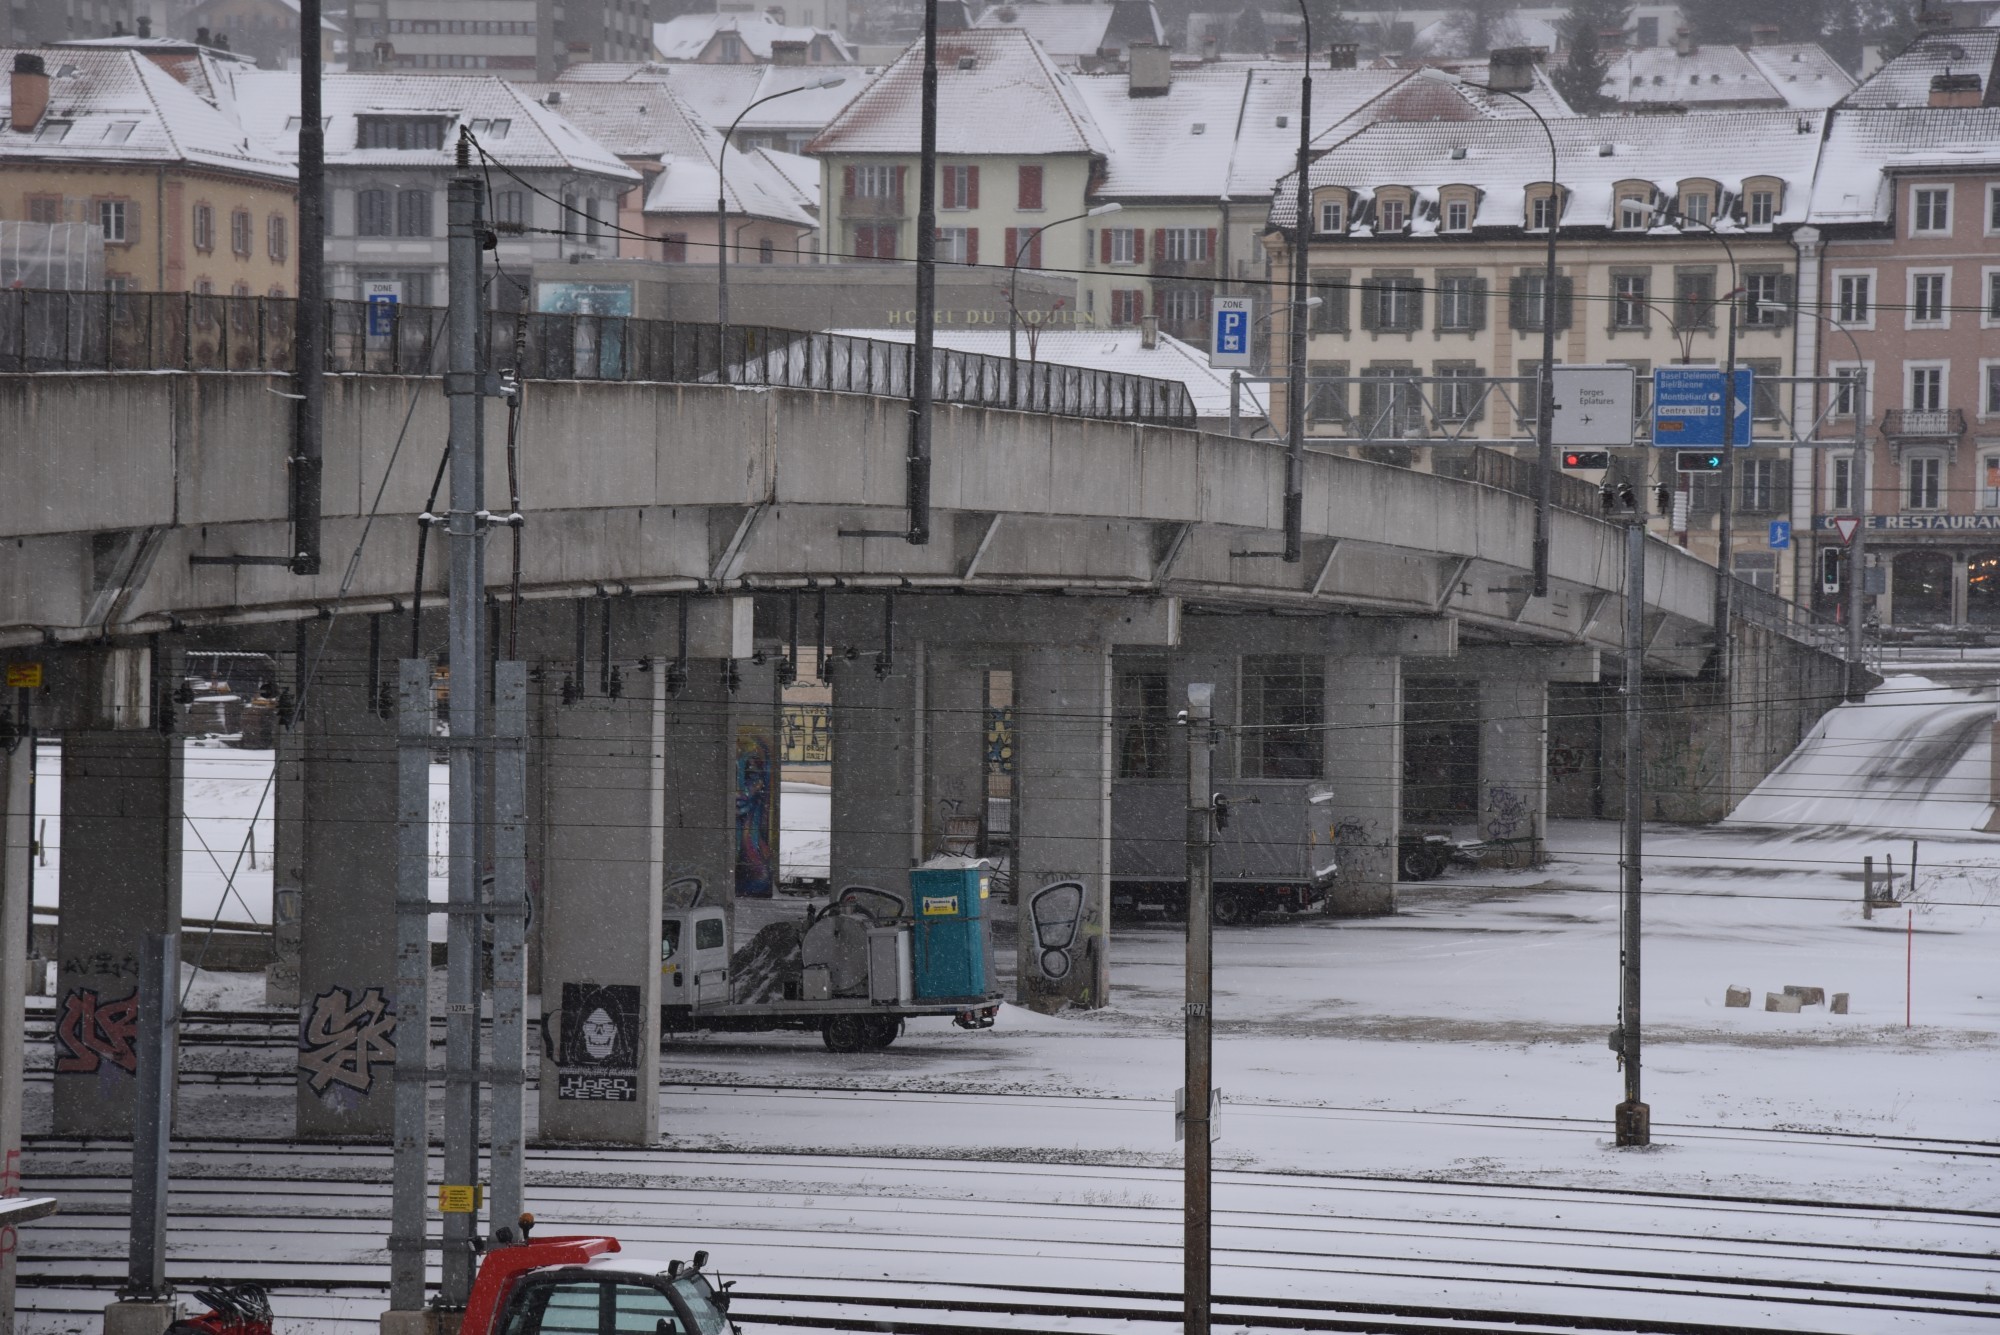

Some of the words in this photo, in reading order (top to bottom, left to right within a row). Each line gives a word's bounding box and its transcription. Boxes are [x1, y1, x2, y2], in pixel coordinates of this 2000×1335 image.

[373, 284, 392, 292] ZONE
[1222, 301, 1243, 309] ZONE
[887, 310, 954, 324] HOEL
[967, 310, 995, 324] DU
[1226, 314, 1239, 334] P
[1580, 389, 1604, 398] Forges
[1580, 398, 1614, 406] Eplatures
[1824, 516, 1876, 529] CE
[1188, 1003, 1204, 1016] 127
[560, 1086, 636, 1100] RESET
